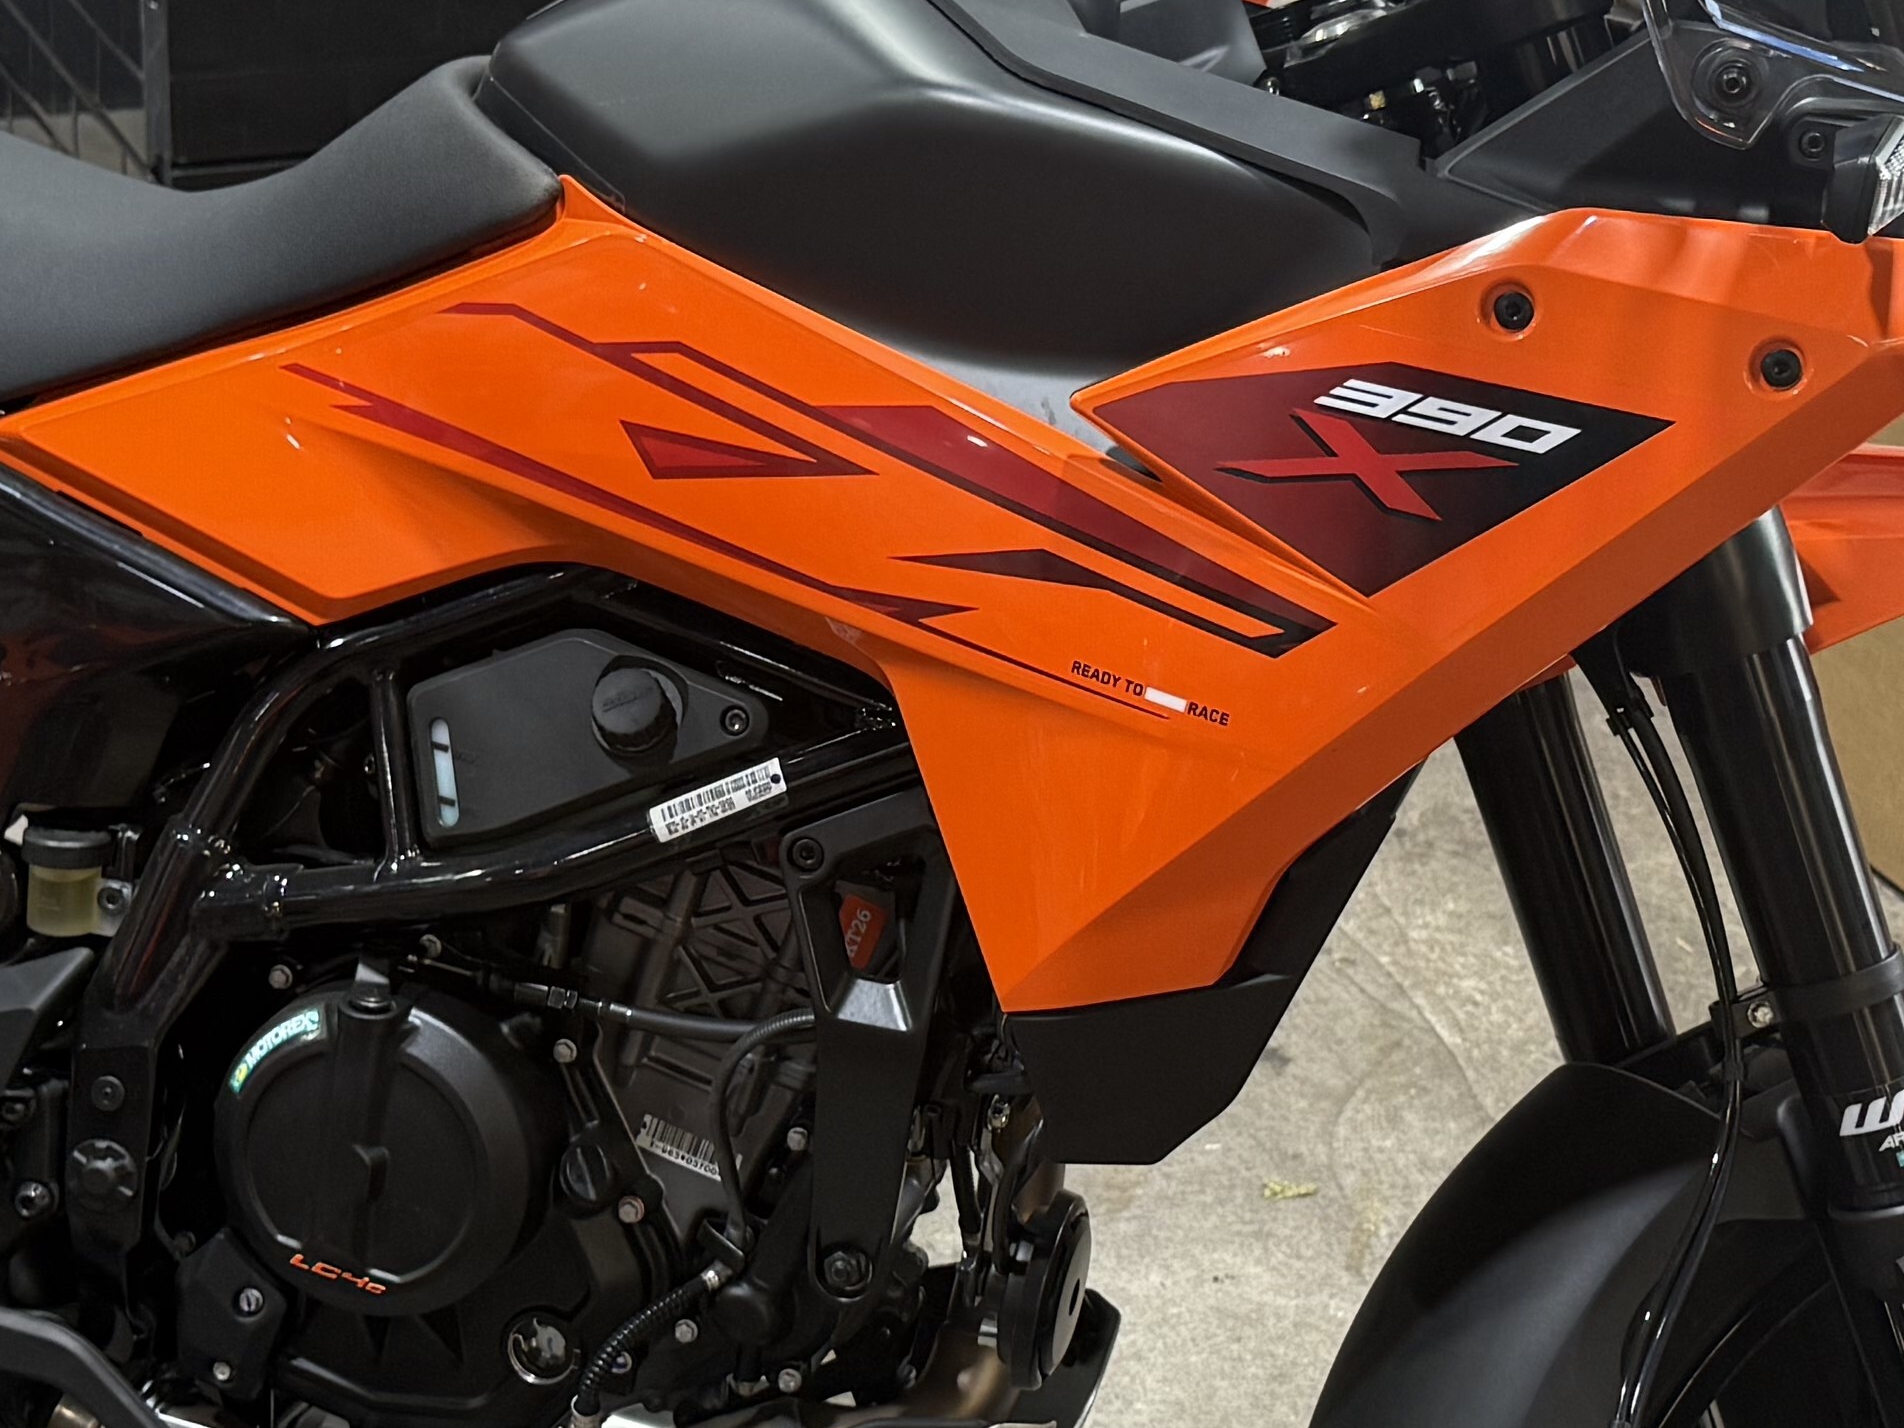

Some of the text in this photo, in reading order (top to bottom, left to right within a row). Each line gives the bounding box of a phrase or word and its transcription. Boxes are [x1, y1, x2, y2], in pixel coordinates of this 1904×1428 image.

[1313, 378, 1582, 455] 390
[1216, 408, 1520, 523] X
[1071, 660, 1229, 727] READY TO RACE
[244, 1008, 321, 1071] MOTOREX
